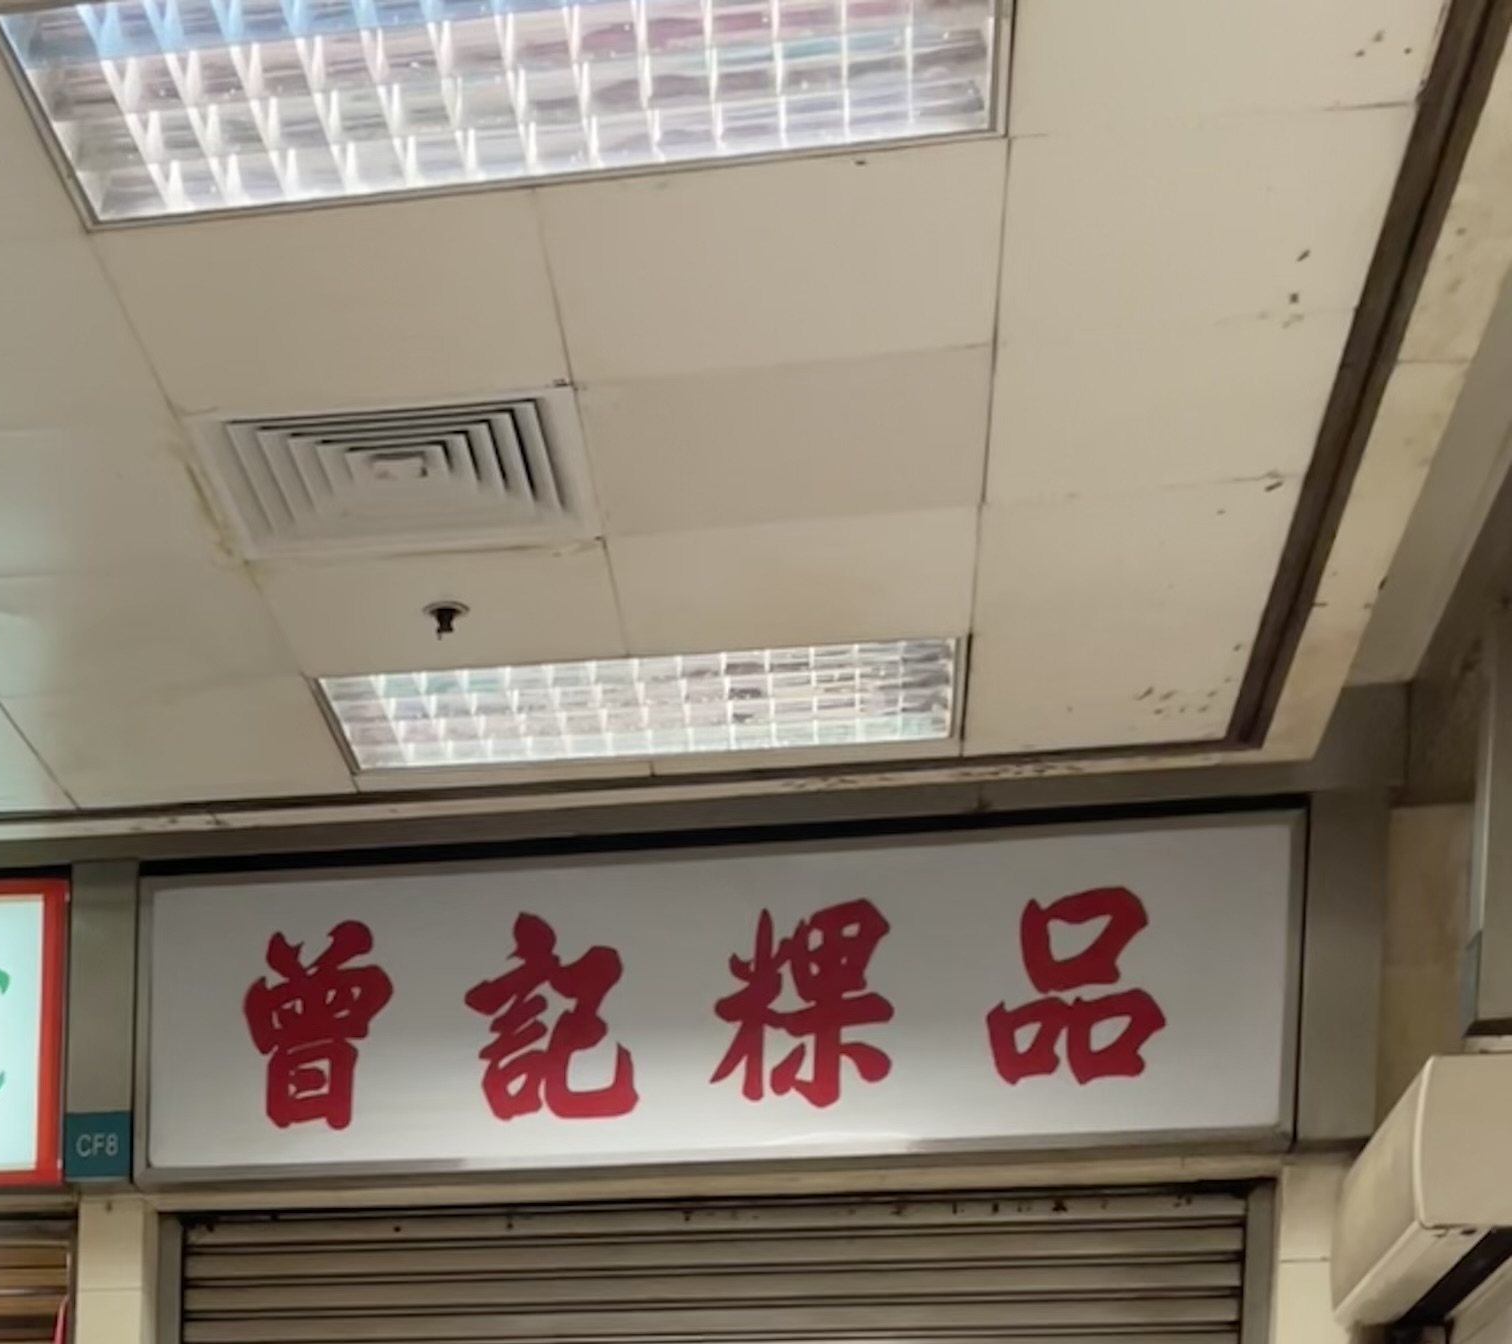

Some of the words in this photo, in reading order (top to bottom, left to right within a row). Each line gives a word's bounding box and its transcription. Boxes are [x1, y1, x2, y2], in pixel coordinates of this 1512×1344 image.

[242, 886, 1167, 1131] 曾記粿品
[76, 1132, 118, 1157] CF8
